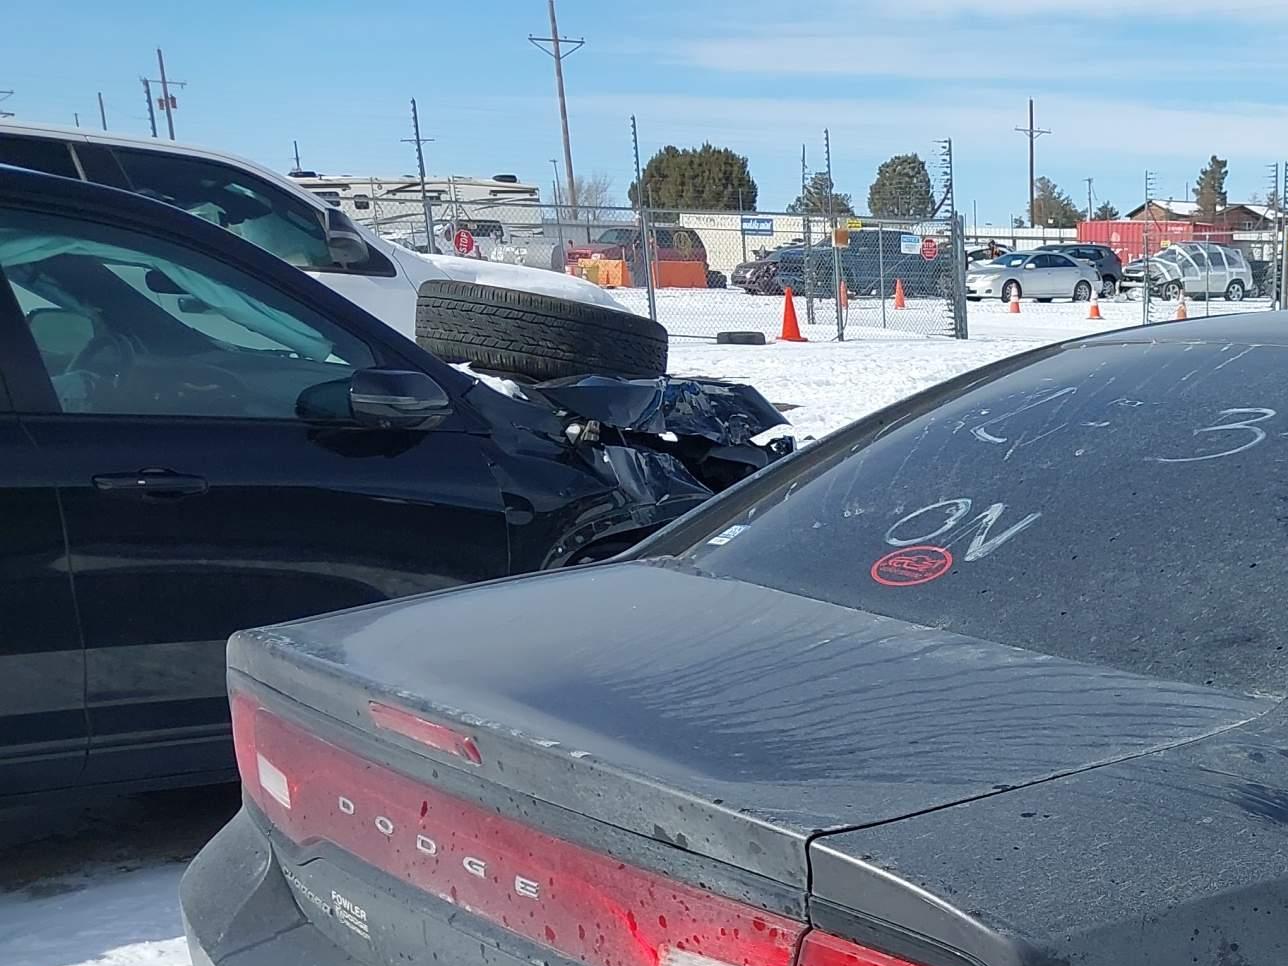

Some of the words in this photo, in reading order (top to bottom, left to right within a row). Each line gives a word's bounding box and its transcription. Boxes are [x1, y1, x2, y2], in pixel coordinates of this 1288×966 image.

[459, 231, 469, 254] STOP
[338, 796, 540, 900] DODGE
[331, 890, 368, 922] FOWLER
